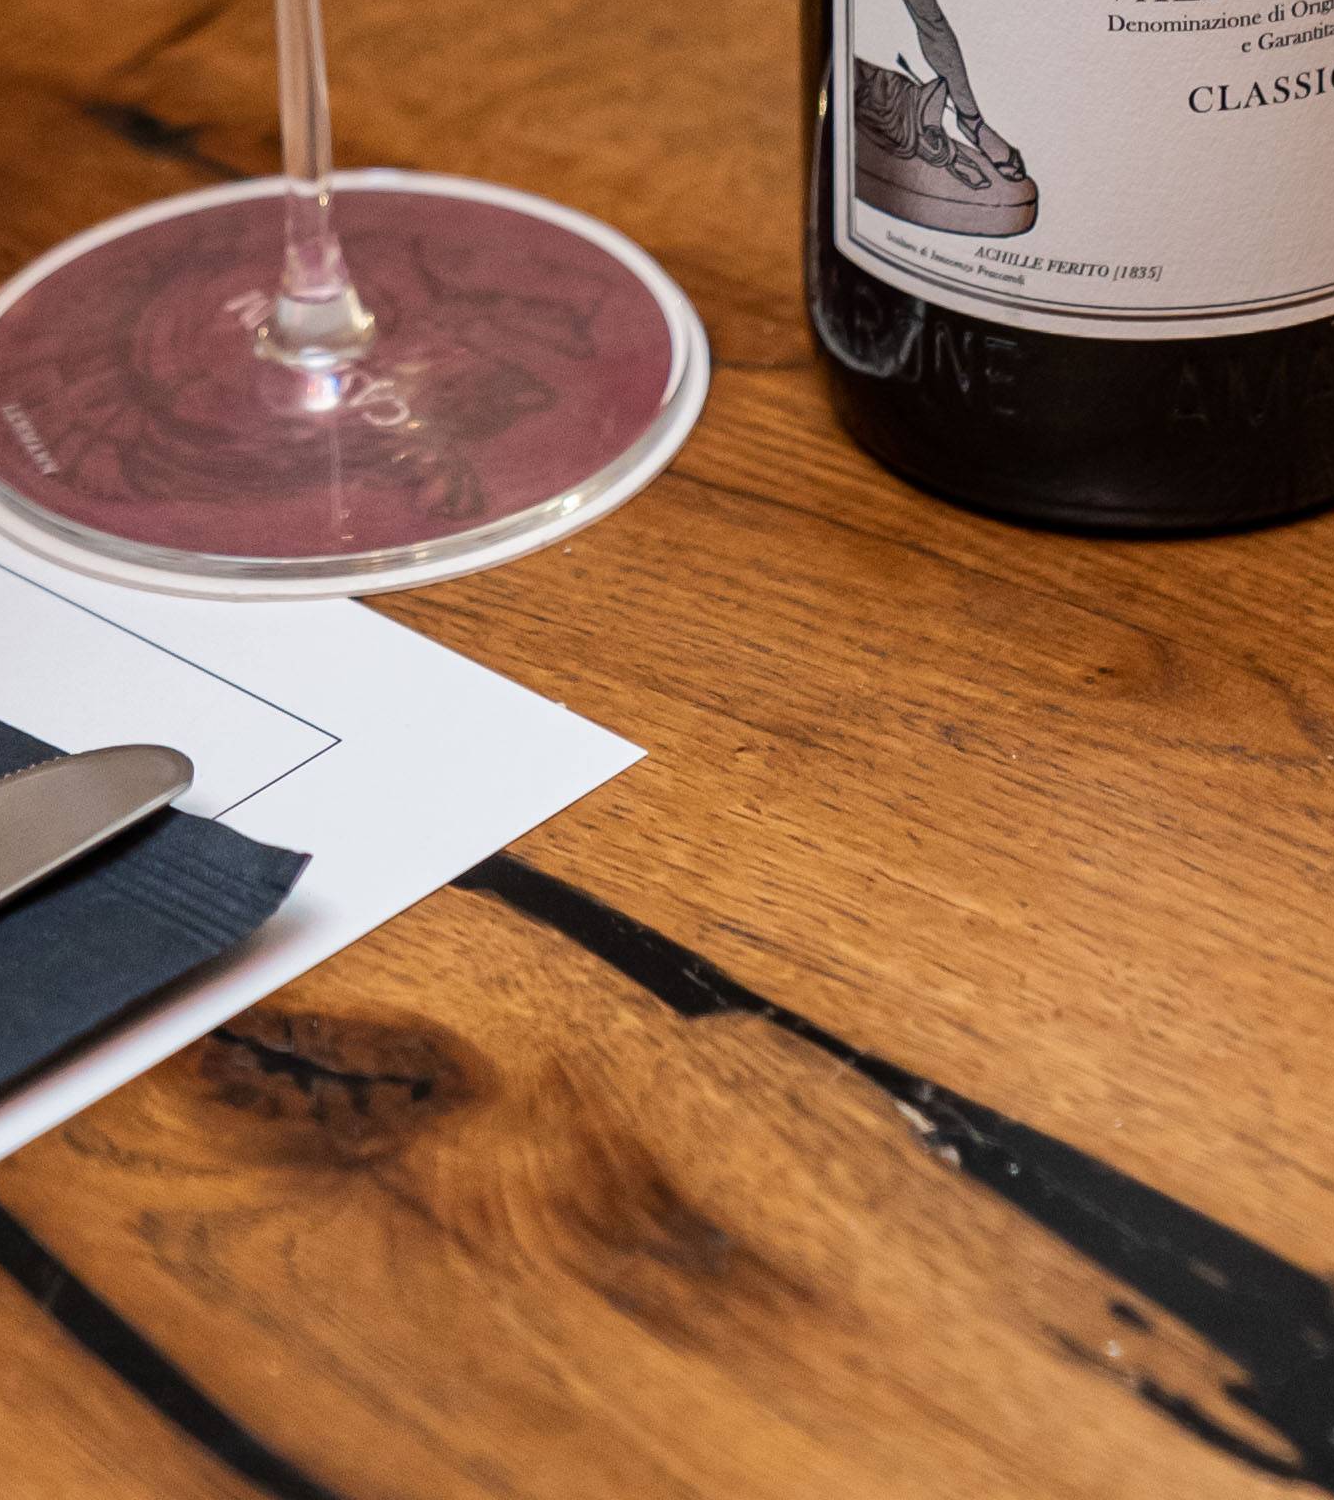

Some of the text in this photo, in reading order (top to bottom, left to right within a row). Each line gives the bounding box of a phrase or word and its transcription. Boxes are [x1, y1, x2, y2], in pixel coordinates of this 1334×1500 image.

[1107, 12, 1262, 32] Denominazione
[1267, 3, 1285, 23] di
[1241, 40, 1252, 54] e
[974, 245, 1163, 282] ACHILLE FERITO [1835]
